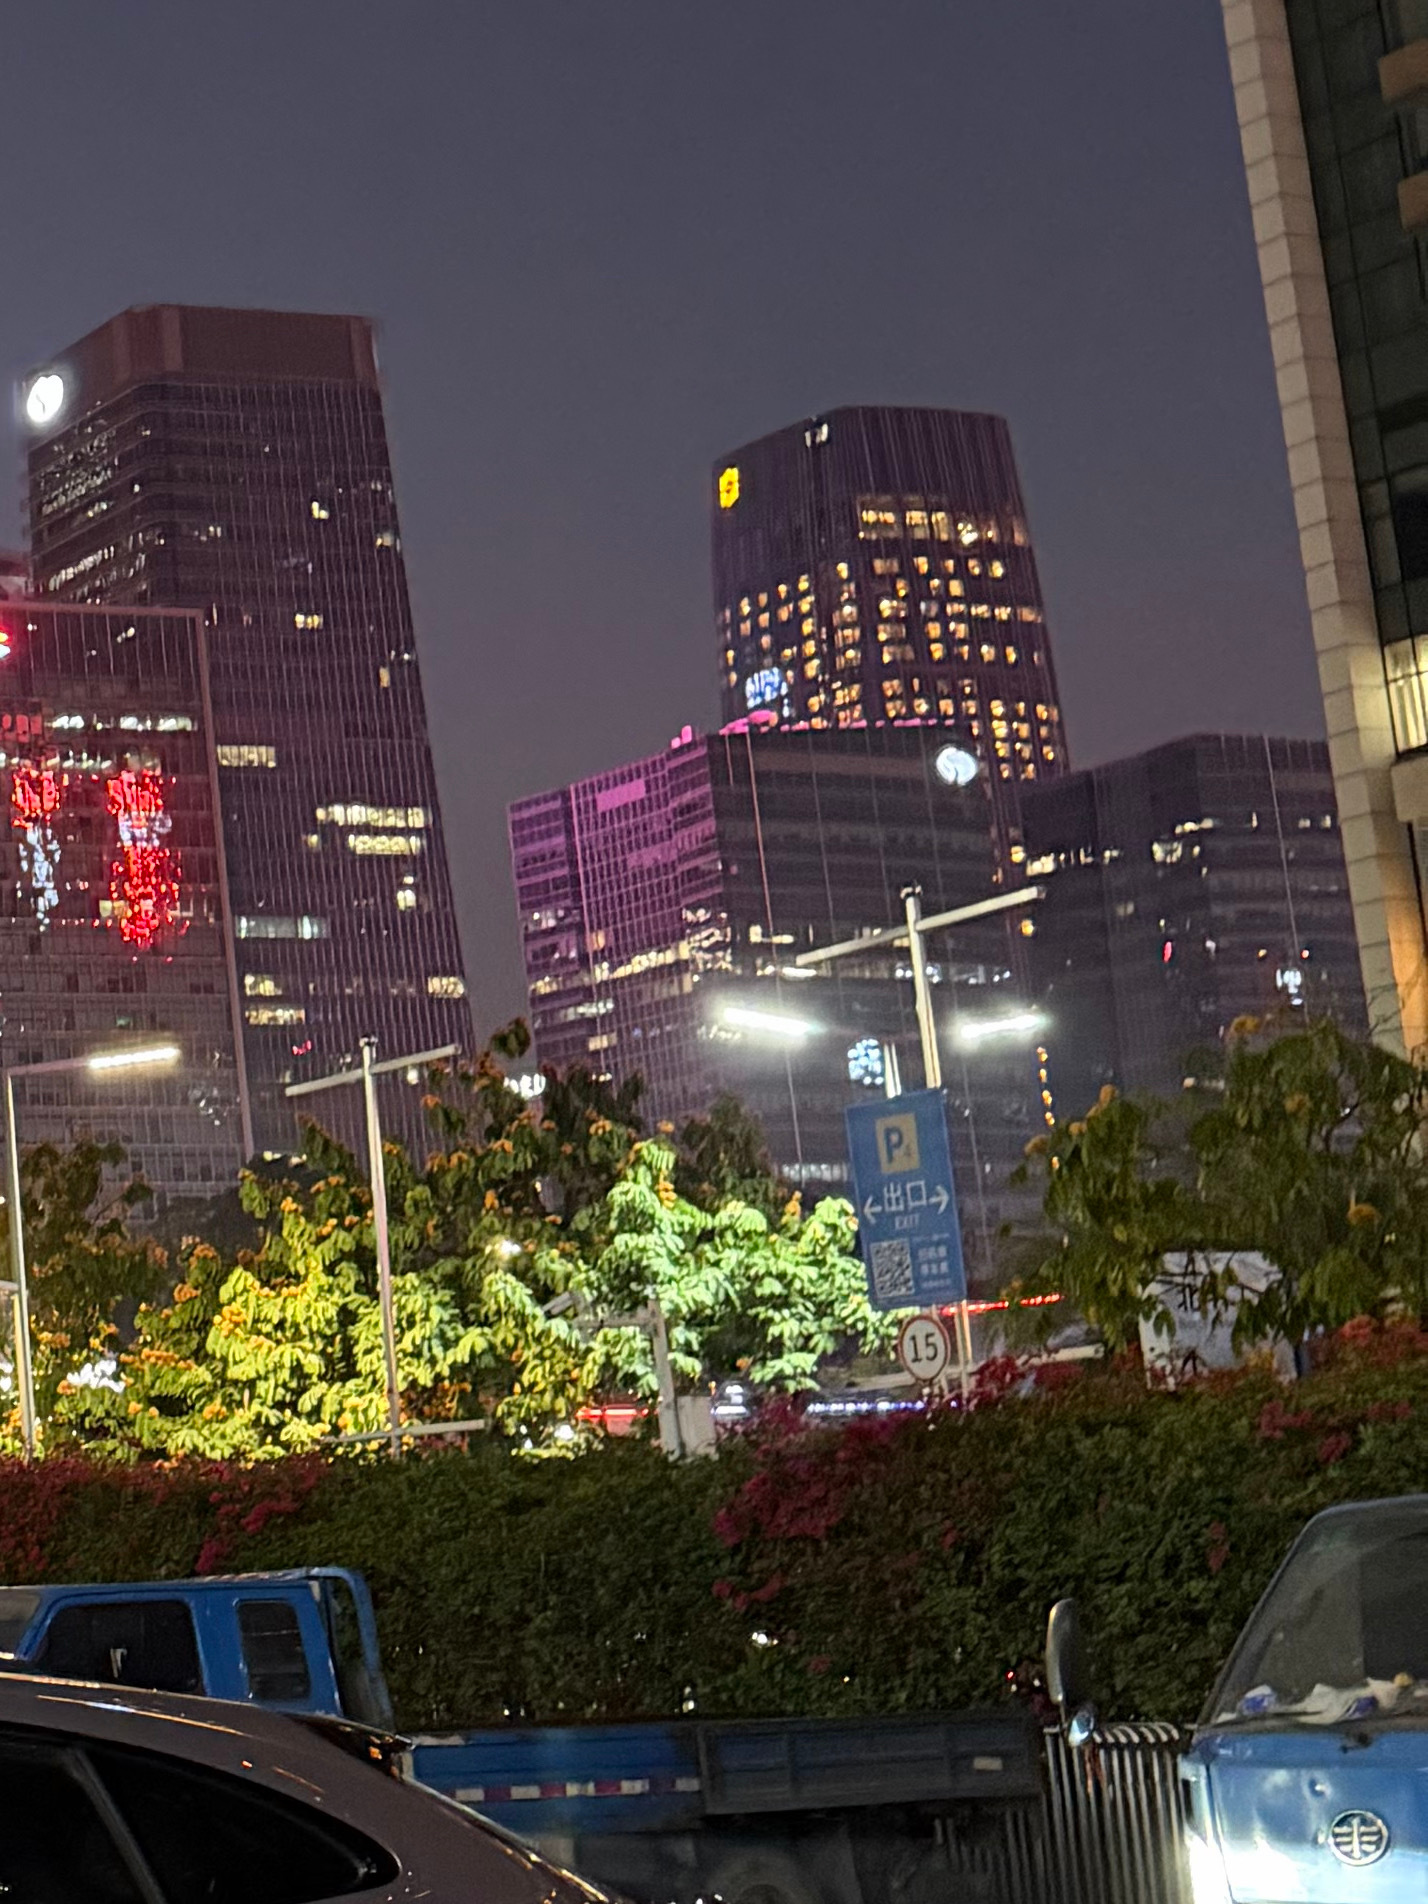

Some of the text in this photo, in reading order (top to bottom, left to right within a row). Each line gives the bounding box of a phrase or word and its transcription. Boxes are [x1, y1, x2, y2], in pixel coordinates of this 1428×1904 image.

[883, 1180, 927, 1213] 出口
[894, 1213, 920, 1230] EXIT
[909, 1332, 938, 1363] 15
